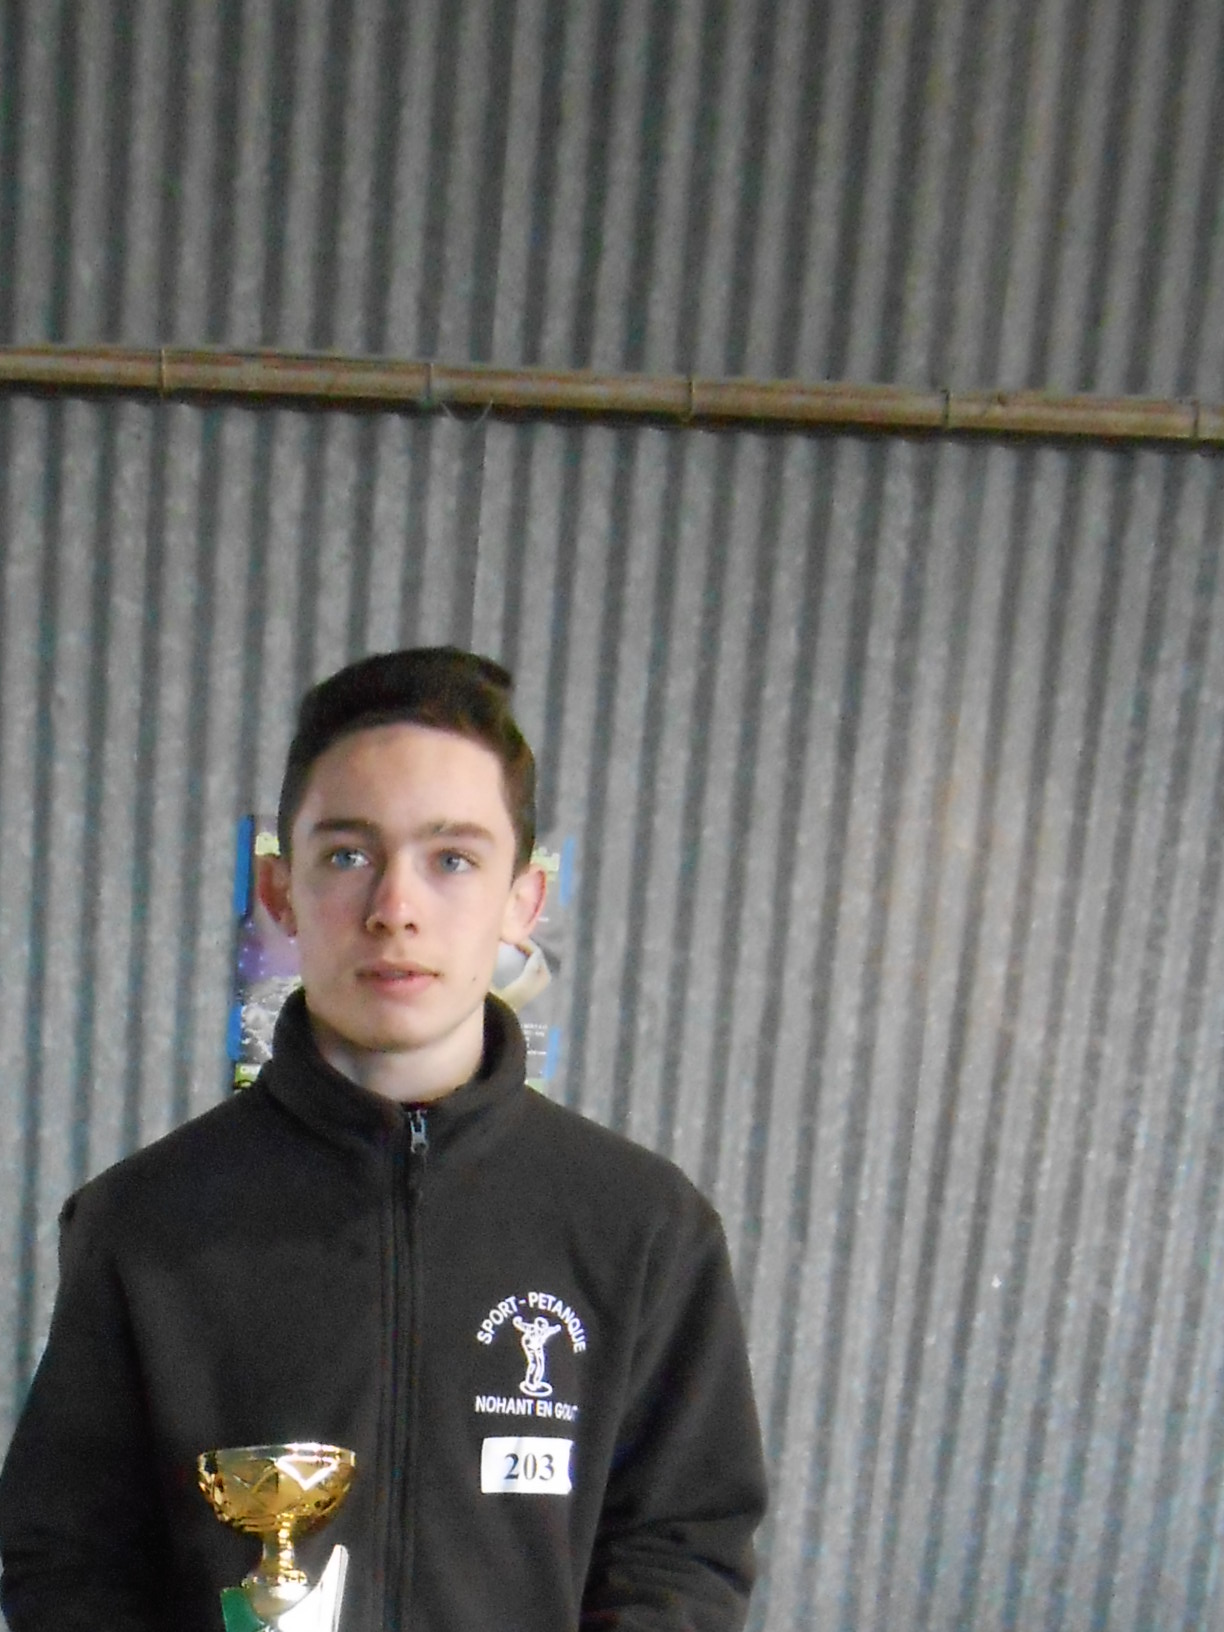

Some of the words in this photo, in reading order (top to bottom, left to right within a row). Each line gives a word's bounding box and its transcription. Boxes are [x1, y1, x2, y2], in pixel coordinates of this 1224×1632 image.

[475, 1395, 534, 1415] NOHANT
[536, 1400, 553, 1417] EN
[503, 1452, 556, 1481] 203
